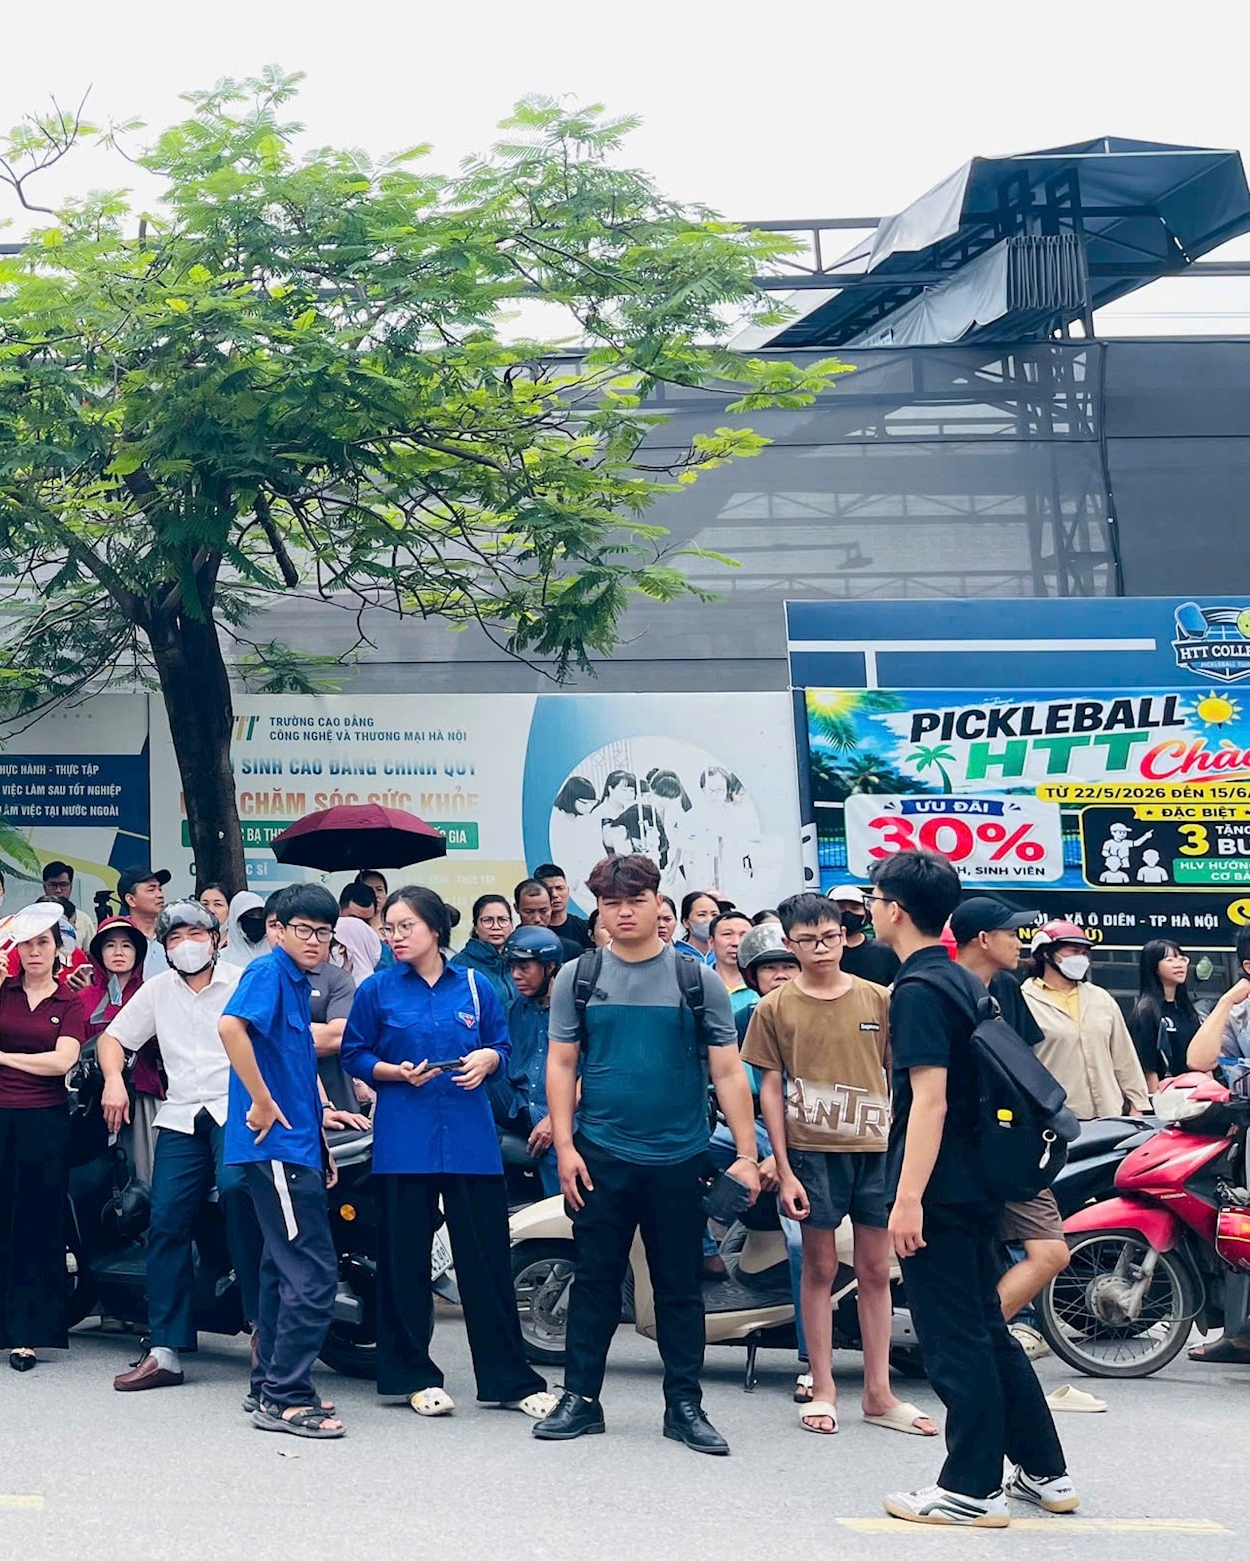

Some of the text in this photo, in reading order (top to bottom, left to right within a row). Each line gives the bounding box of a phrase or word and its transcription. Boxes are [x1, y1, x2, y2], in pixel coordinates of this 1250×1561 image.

[1180, 646, 1209, 660] HTT
[269, 714, 314, 727] TRƯỜNG
[318, 717, 341, 727] CAO
[910, 696, 1185, 742] PICKLEBALL
[269, 729, 468, 744] CÔNG NGHỆ VÀ THƯƠNG MẠI HÀ NỘI
[965, 731, 1150, 780] HTT
[20, 763, 47, 775] HÀNH
[55, 763, 79, 777] THỰC
[81, 763, 100, 777] TẬP
[241, 757, 283, 775] SINH
[289, 757, 323, 775] CAO
[2, 783, 23, 797] VIỆC
[25, 783, 46, 796] LÀM
[47, 785, 67, 796] SAU
[68, 782, 85, 796] TỐT
[87, 783, 122, 798] NGHIỆP
[1045, 784, 1070, 799] TỪ
[1071, 787, 1166, 799] 22/5/2026
[1170, 785, 1205, 799] ĐẾN
[239, 787, 306, 815] CHĂM
[915, 799, 990, 813] ƯU ĐÃI
[21, 804, 42, 818] VIỆC
[44, 805, 60, 818] TẠI
[61, 803, 88, 817] NƯỚC
[90, 804, 120, 817] NGOÀI
[1161, 805, 1237, 820] ĐẶC BIỆT
[246, 829, 262, 844] BẠ
[262, 829, 288, 842] TH
[448, 830, 467, 844] GIA
[867, 816, 1046, 863] 30%
[1177, 823, 1210, 856] 3
[974, 866, 1009, 877] SINH
[1012, 863, 1046, 877] VIÊN
[1180, 860, 1250, 871] HLV HƯỚN
[1210, 871, 1231, 881] CƠ
[1064, 912, 1085, 926] XÃ
[1088, 912, 1100, 926] Ô
[1102, 913, 1136, 926] DIÊN
[1149, 914, 1168, 927] TP
[1170, 912, 1192, 927] HÀ
[1194, 913, 1219, 930] NỘI
